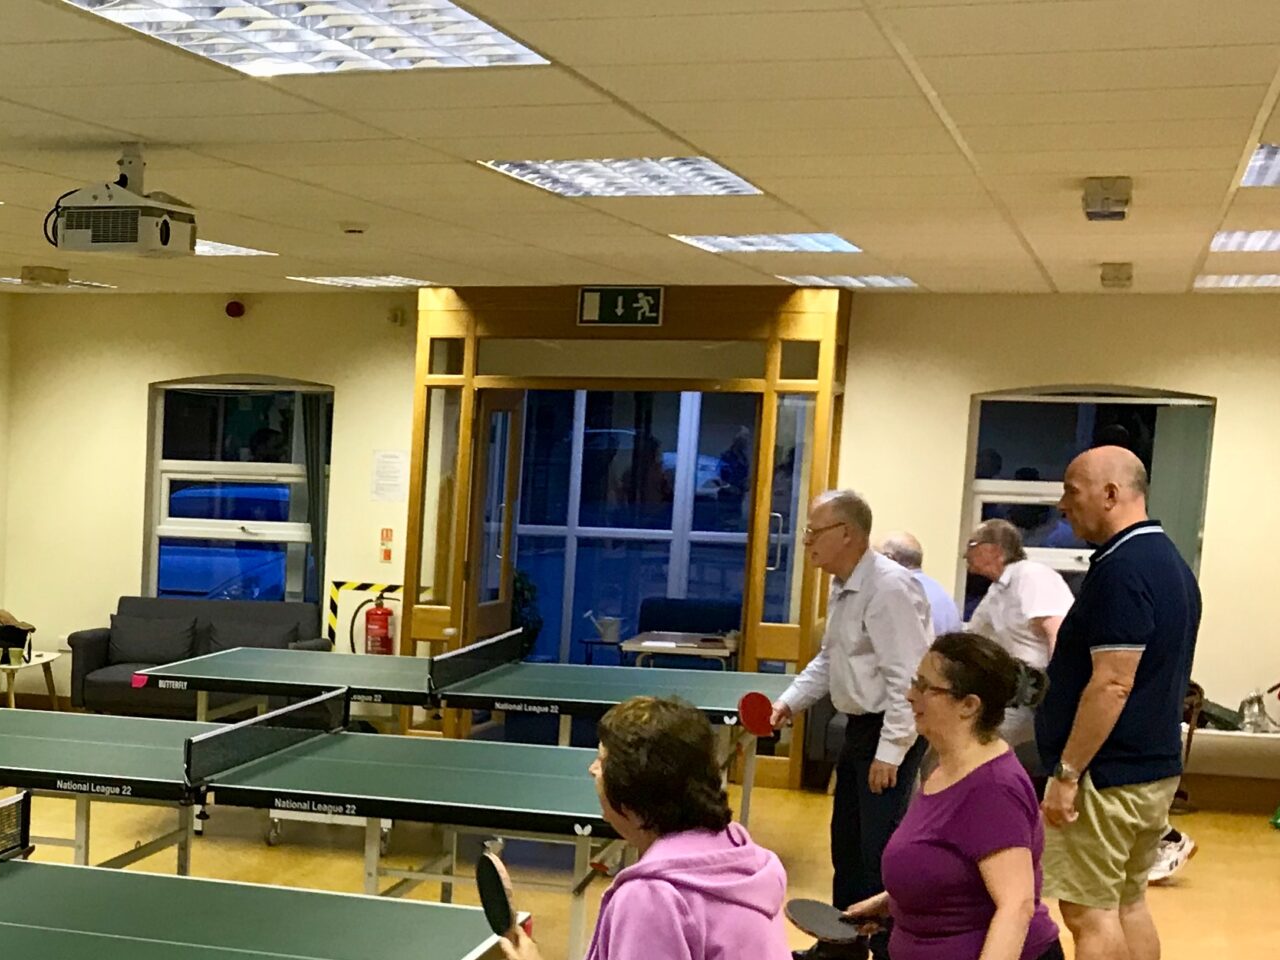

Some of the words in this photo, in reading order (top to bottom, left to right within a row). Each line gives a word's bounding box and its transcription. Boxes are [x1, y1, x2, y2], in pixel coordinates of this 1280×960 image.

[494, 702, 524, 712] National
[524, 704, 549, 714] League
[56, 780, 90, 792] National
[91, 783, 120, 796] League
[121, 785, 132, 795] 22
[274, 798, 310, 810] National
[311, 801, 343, 814] League
[345, 804, 357, 814] 22
